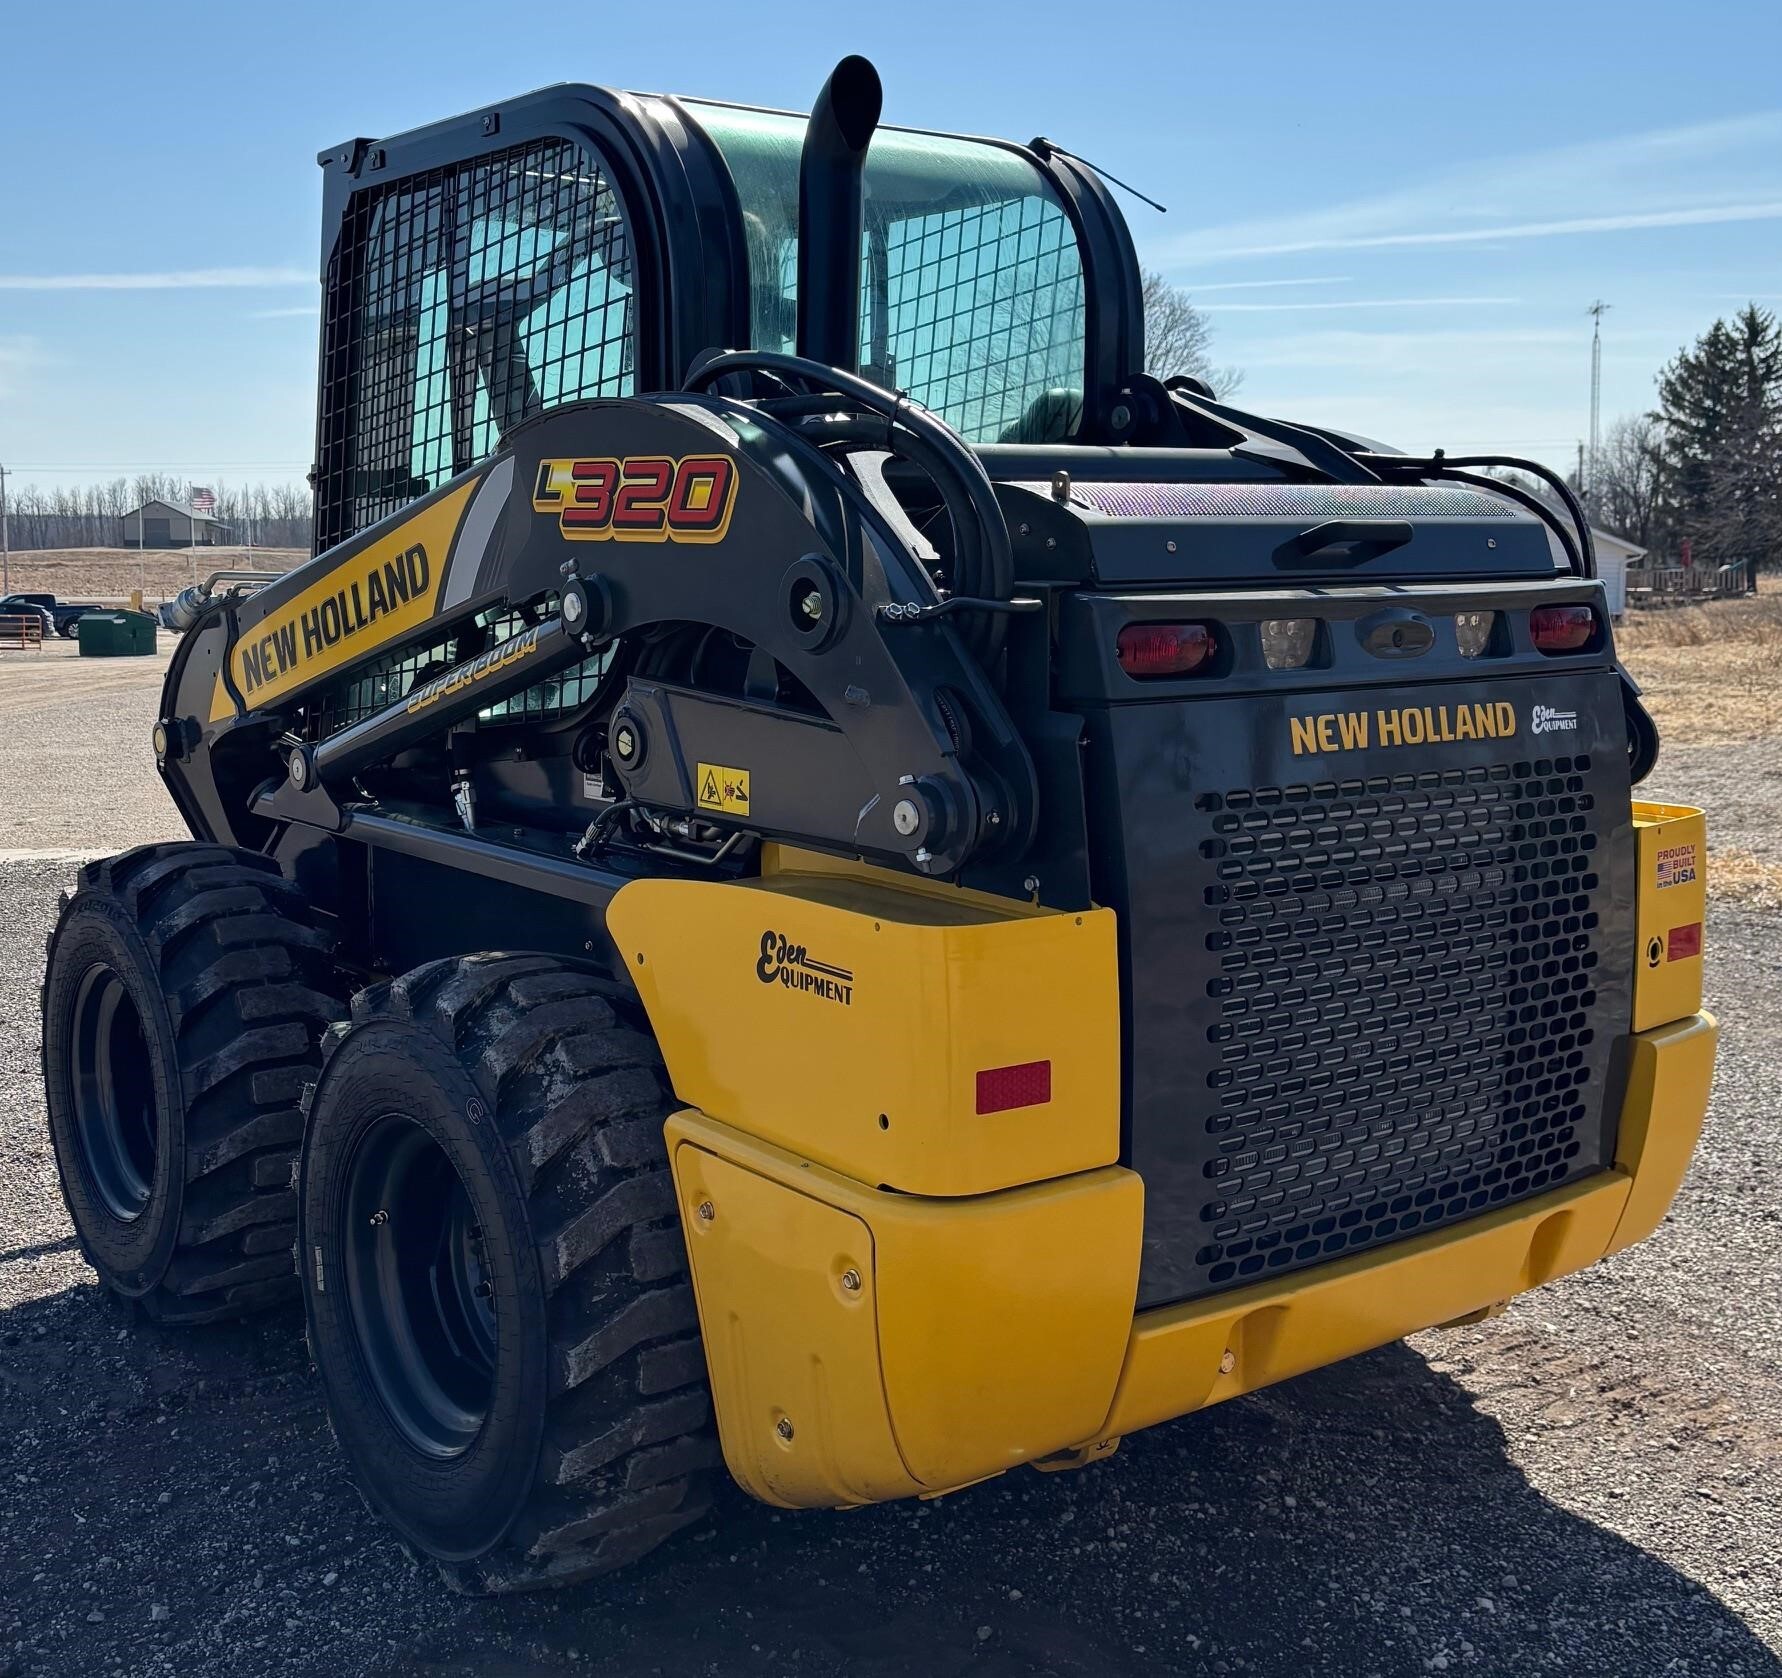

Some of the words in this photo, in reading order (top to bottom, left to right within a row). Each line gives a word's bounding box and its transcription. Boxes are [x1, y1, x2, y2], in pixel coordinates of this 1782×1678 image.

[533, 455, 738, 543] L320
[242, 620, 298, 694] NEW
[301, 542, 430, 659] HOLLAND
[1290, 711, 1369, 755] NEW
[1377, 702, 1516, 747] HOLLAND
[1657, 844, 1695, 861] PROUDLY
[1673, 856, 1696, 869] BUILT
[1673, 868, 1696, 884] USA
[757, 930, 807, 983] Eden
